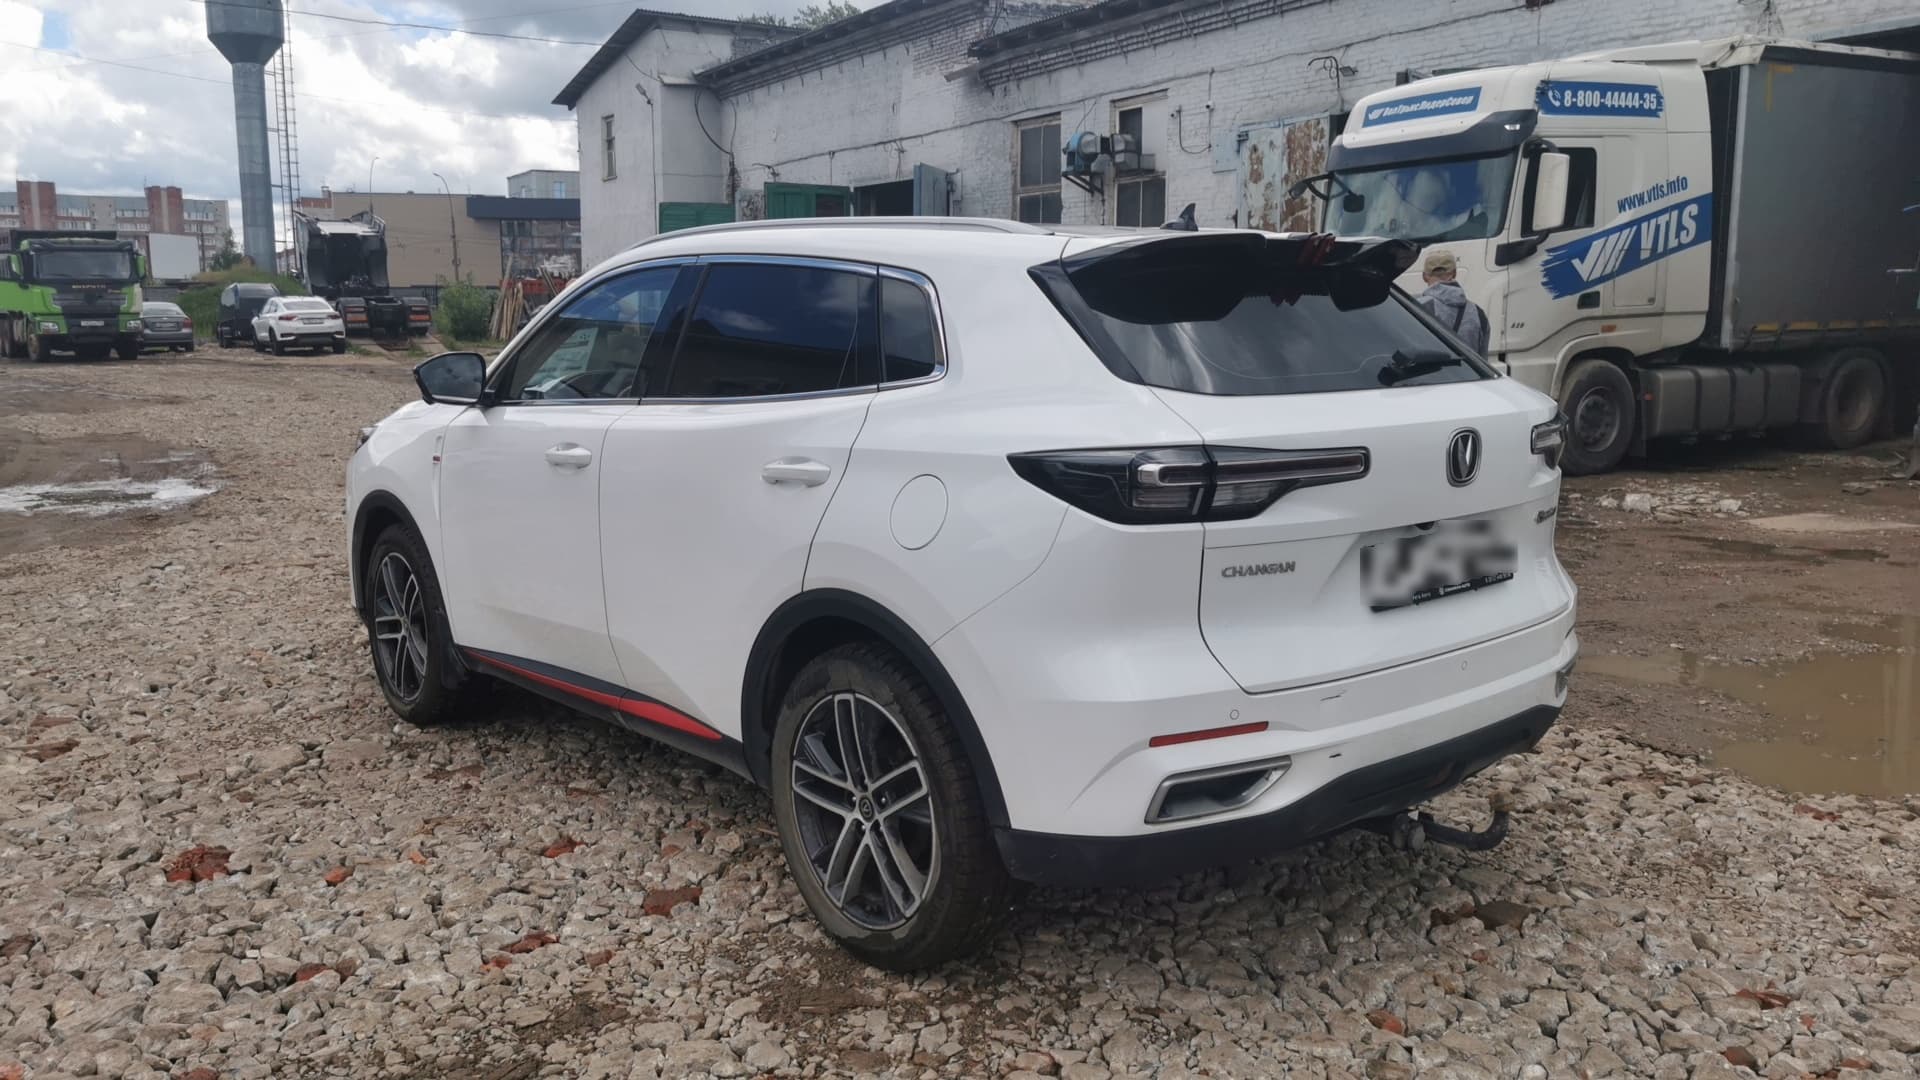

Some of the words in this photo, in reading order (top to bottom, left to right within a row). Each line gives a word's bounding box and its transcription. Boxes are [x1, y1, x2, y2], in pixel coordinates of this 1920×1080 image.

[1564, 90, 1657, 110] 8-800-44444-35
[1617, 176, 1688, 213] www.vtls.info
[1640, 203, 1698, 260] VTLS
[1221, 561, 1296, 577] CHANGAN
